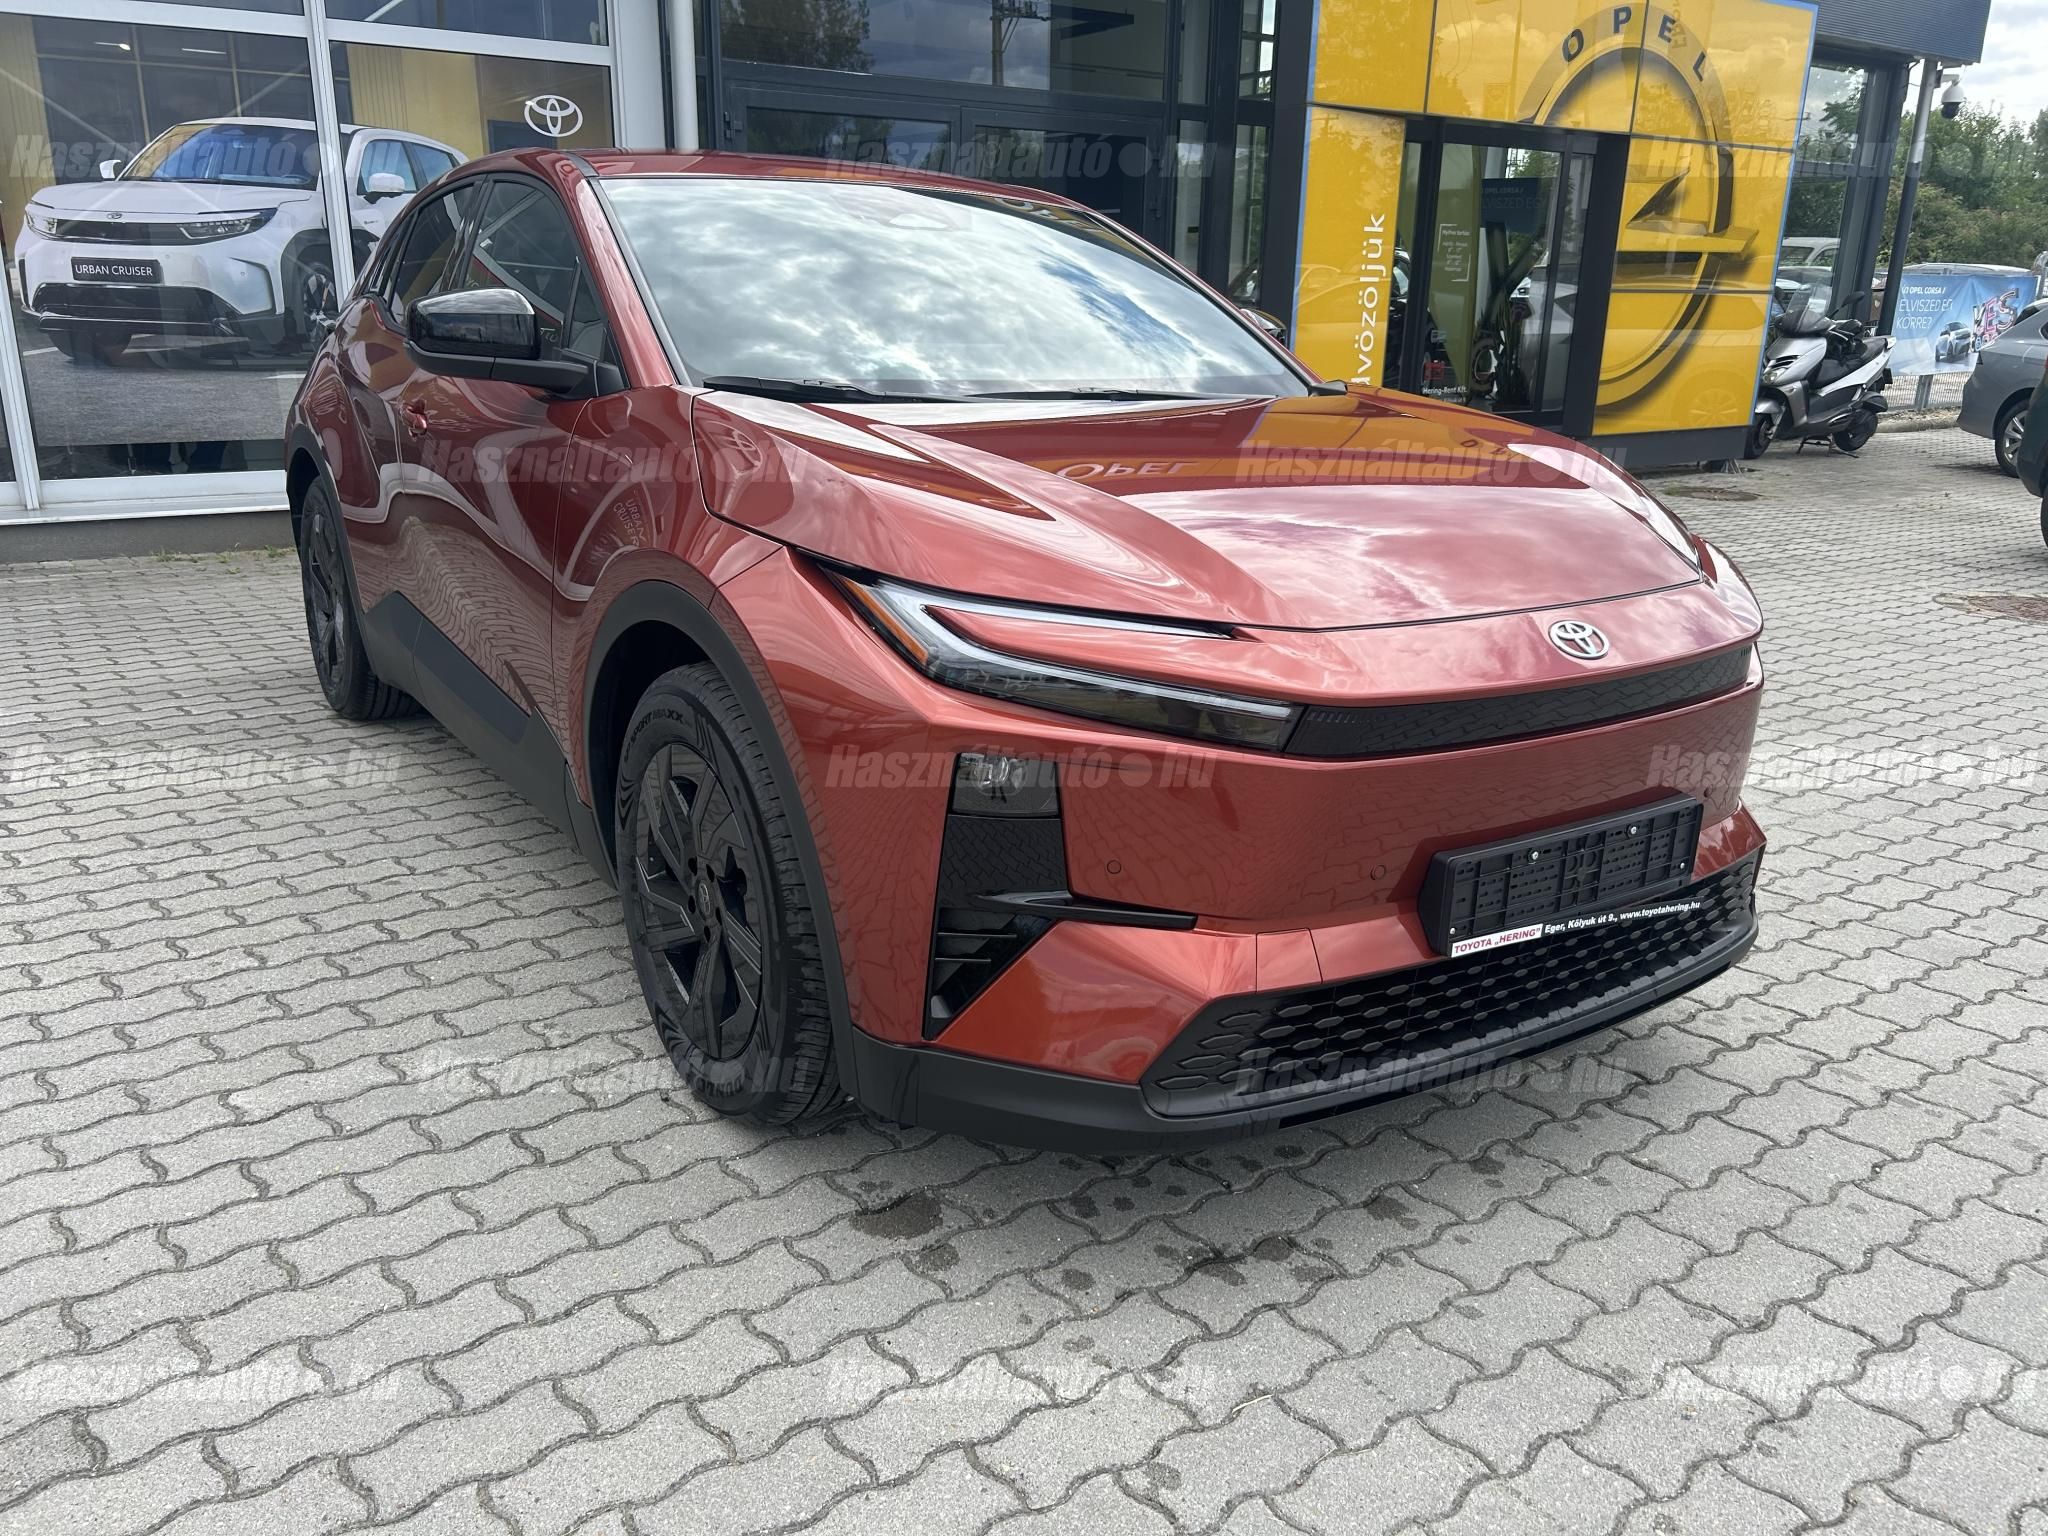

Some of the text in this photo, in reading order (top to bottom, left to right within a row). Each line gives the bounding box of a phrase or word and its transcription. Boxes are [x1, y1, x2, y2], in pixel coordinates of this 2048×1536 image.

[1562, 6, 1706, 82] OPEL
[75, 264, 153, 276] URBAN CRUISER
[1454, 938, 1492, 954] TOYOTA
[1545, 922, 1565, 934] Eger,
[1598, 914, 1608, 924] út
[1620, 901, 1701, 921] www.toyotahering.hu
